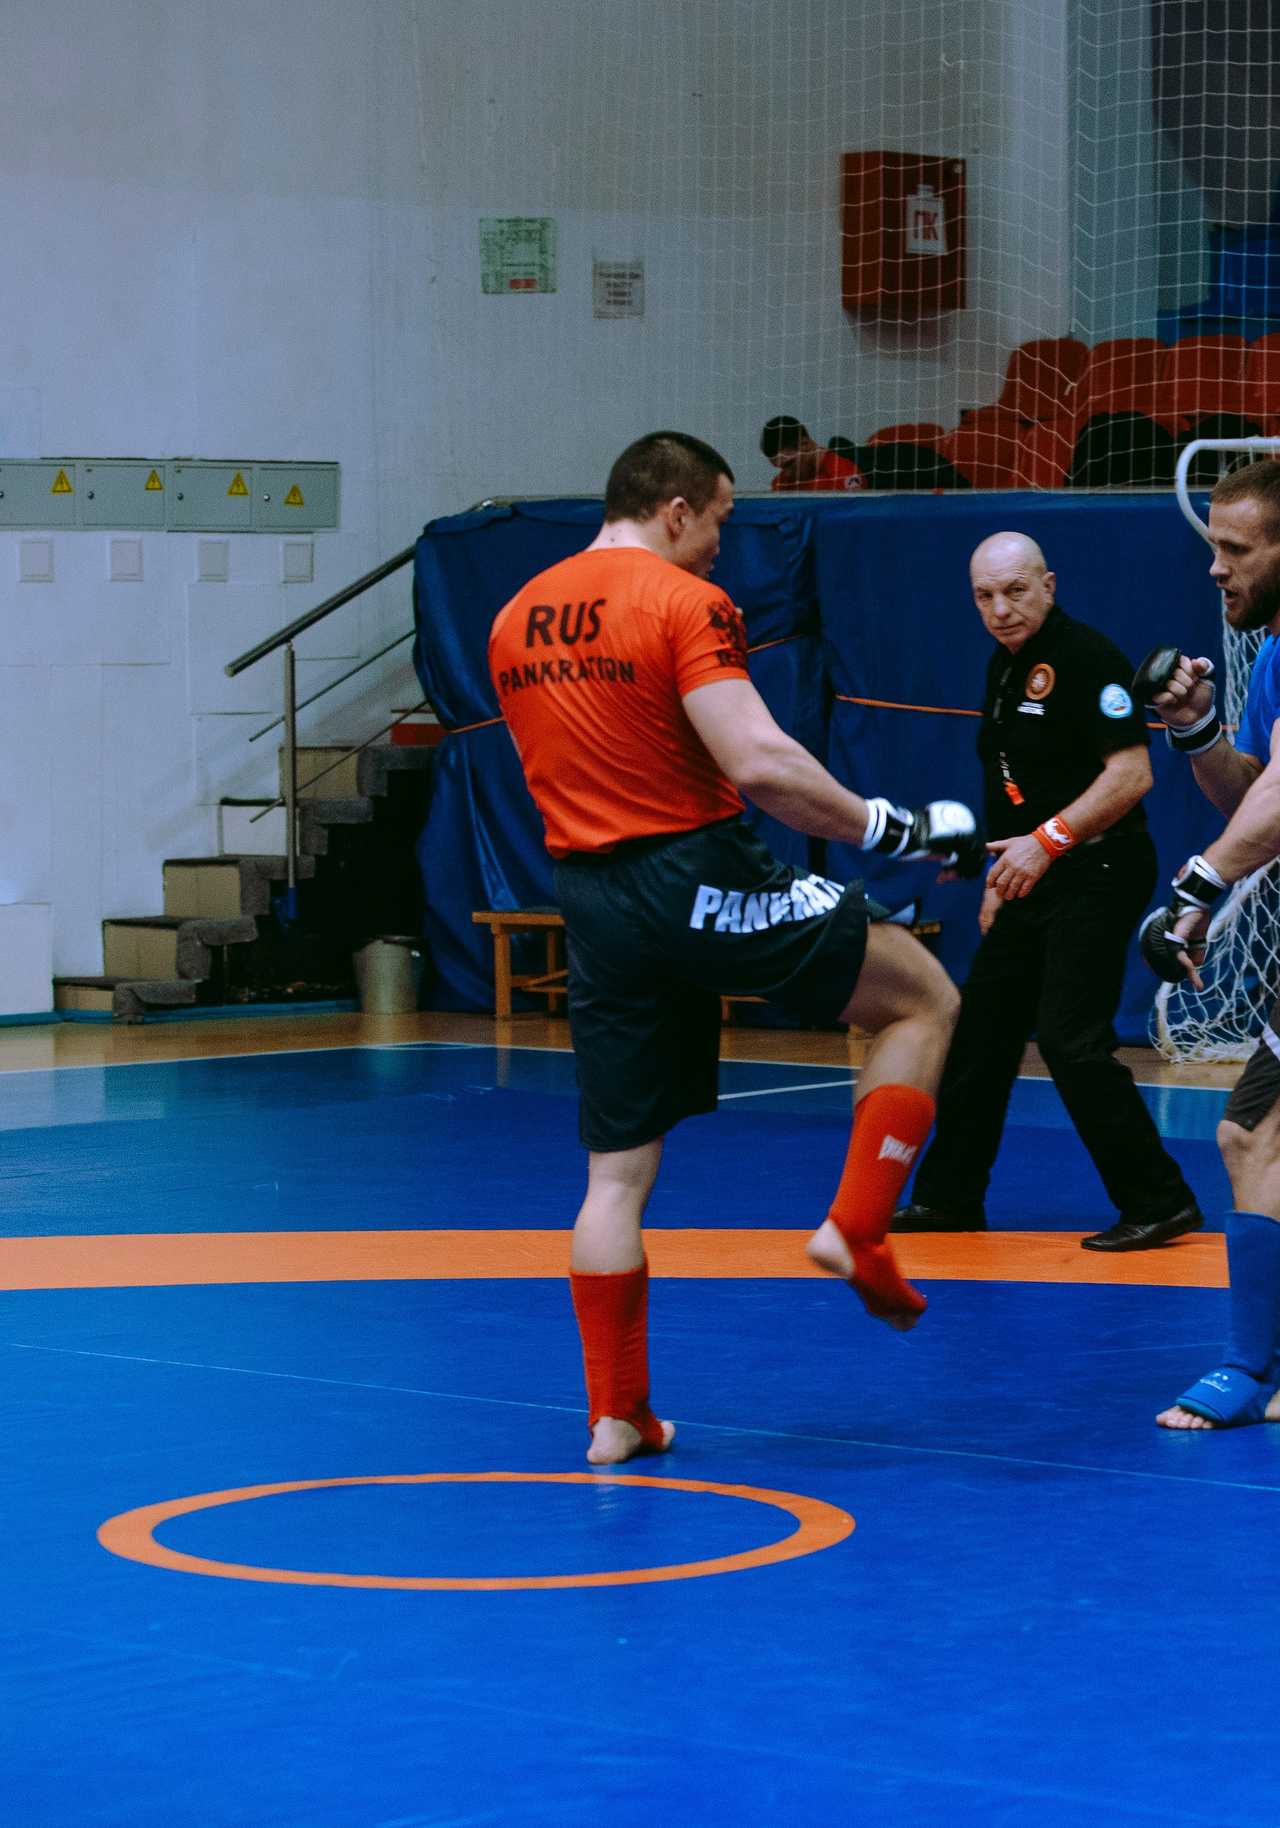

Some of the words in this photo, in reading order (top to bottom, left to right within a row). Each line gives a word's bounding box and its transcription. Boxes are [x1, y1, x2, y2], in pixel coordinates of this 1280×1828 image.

[913, 210, 940, 241] ПК
[526, 598, 606, 648] RUS
[499, 656, 636, 697] PANKRATION
